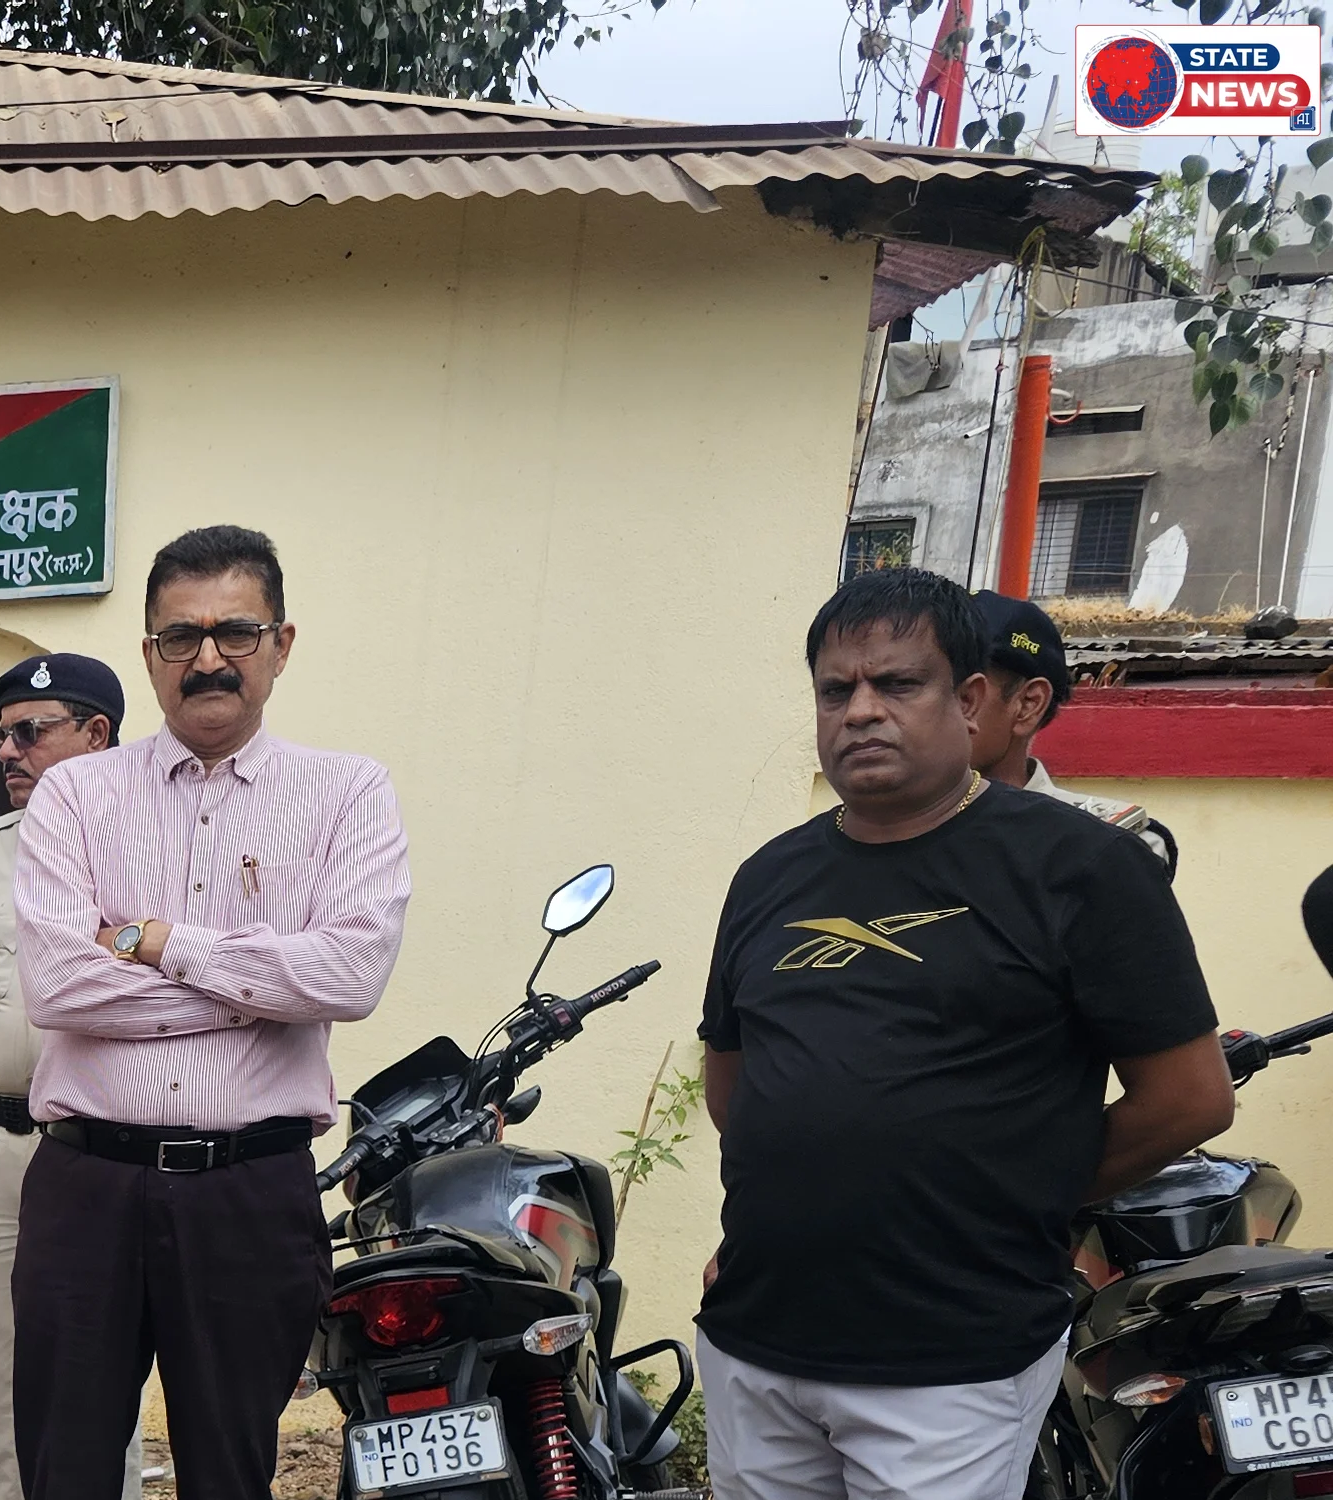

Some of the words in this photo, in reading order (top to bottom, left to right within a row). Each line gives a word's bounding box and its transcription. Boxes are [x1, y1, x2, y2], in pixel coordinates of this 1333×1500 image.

[590, 978, 627, 1003] HONDA
[1231, 1417, 1253, 1428] IND
[361, 1452, 379, 1462] IND
